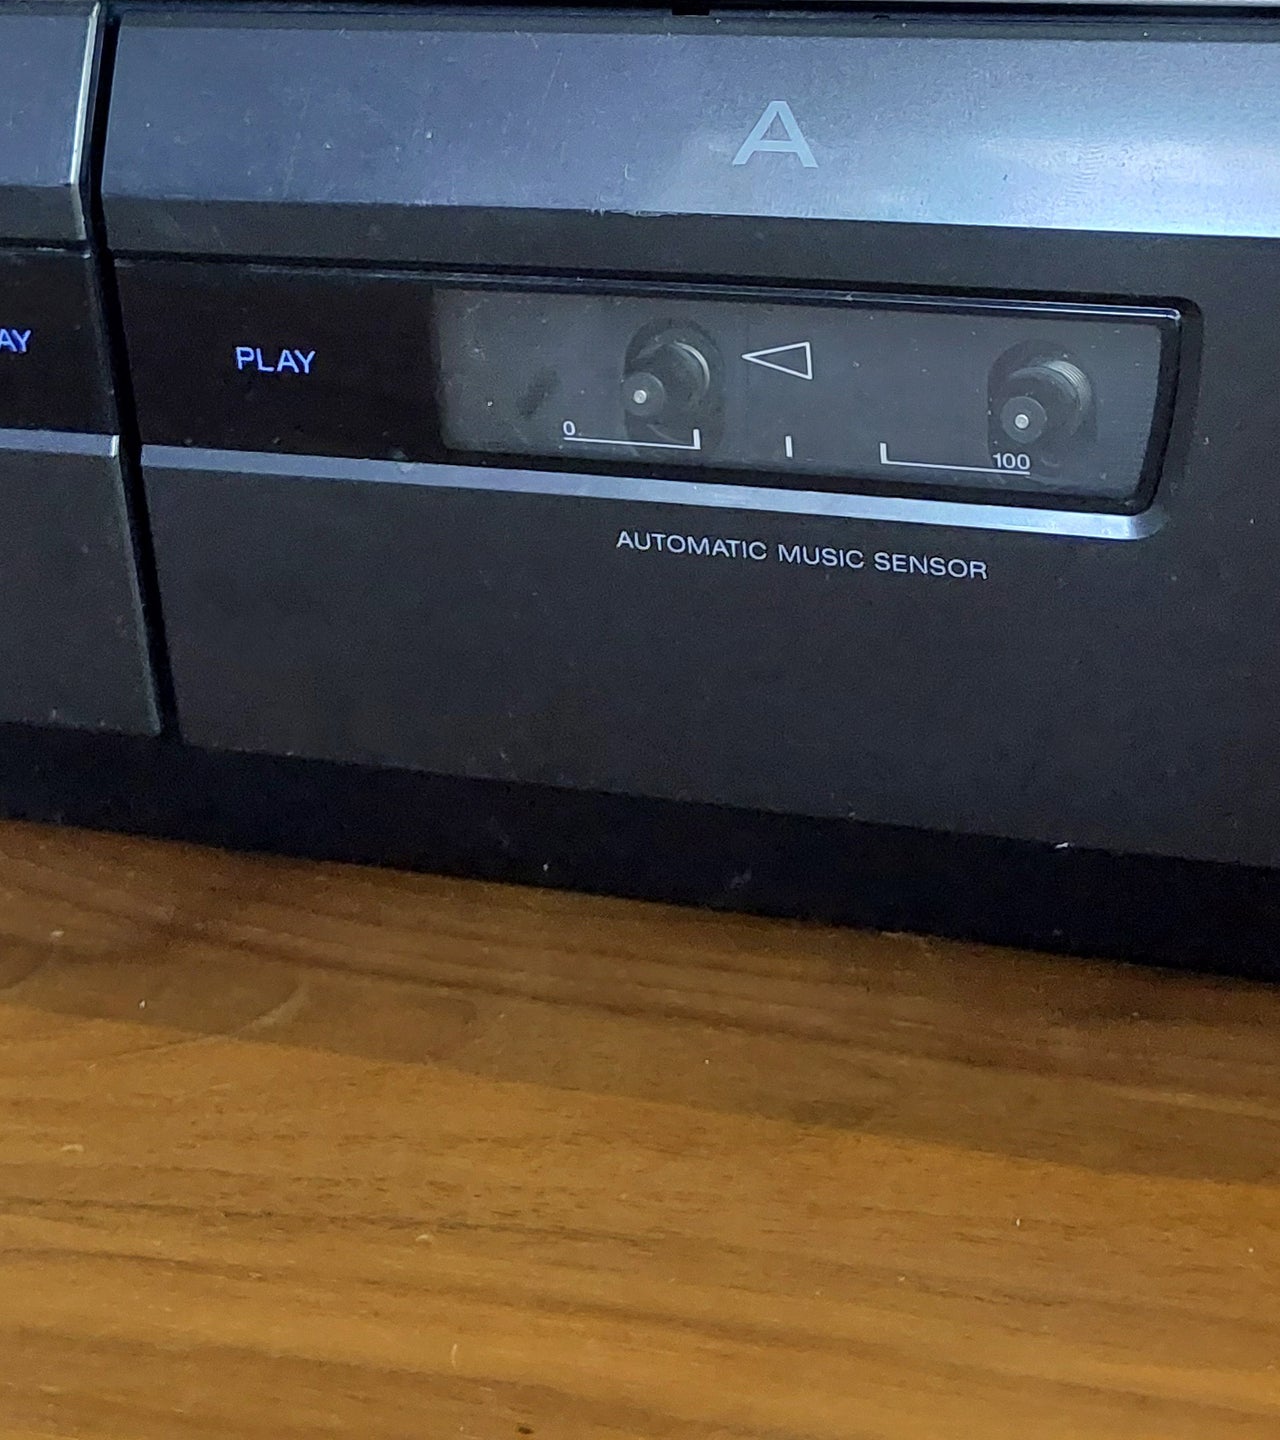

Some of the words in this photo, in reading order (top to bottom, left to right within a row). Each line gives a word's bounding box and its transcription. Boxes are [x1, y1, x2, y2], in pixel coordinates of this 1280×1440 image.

[732, 100, 818, 168] A
[235, 346, 316, 374] PLAY
[562, 420, 576, 437] 0
[992, 452, 1031, 470] 100
[616, 531, 768, 560] AUTOMATIC
[778, 544, 865, 569] MUSIC
[874, 551, 988, 581] SENSOR
